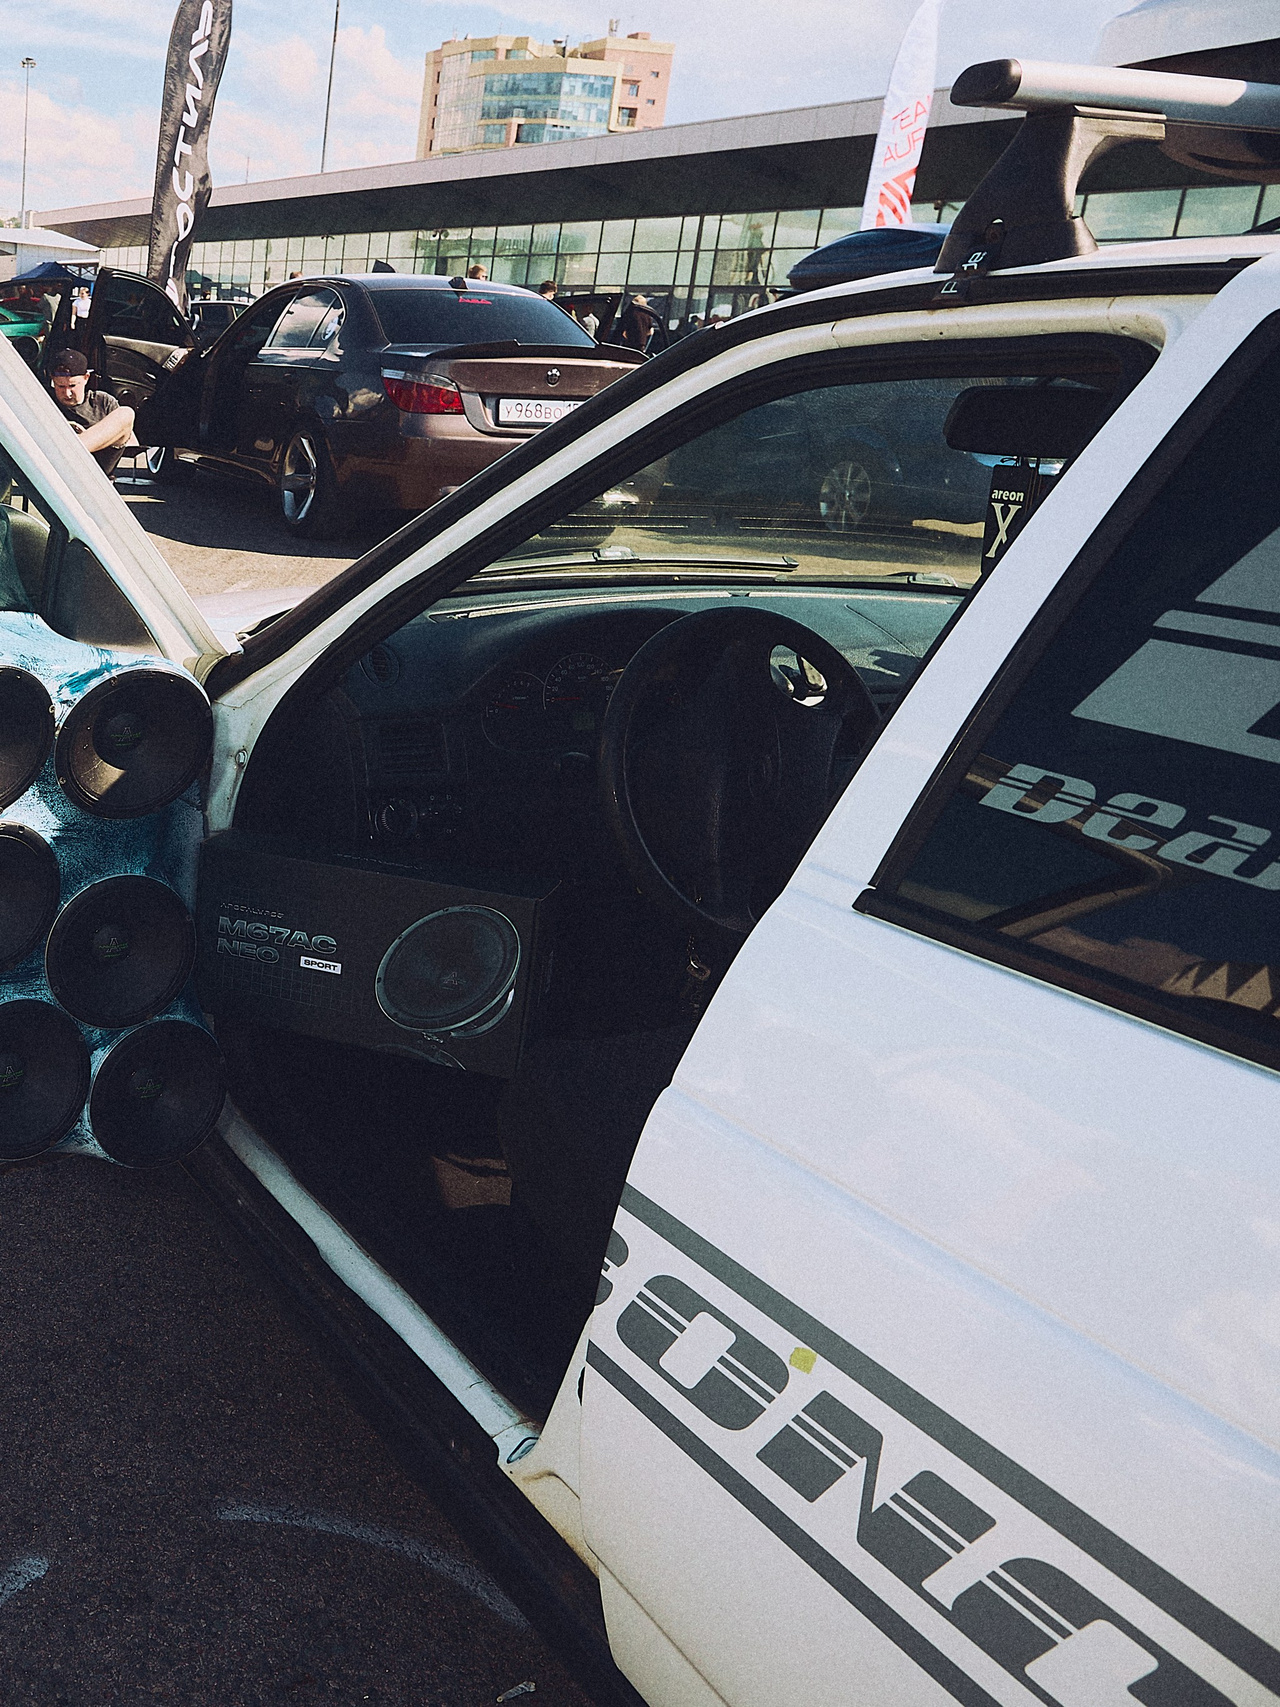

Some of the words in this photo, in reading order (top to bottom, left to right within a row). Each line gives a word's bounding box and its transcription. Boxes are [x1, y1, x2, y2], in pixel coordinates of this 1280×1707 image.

[991, 489, 1024, 502] areon
[984, 502, 1022, 558] X
[218, 916, 337, 954] M67AC
[217, 938, 280, 964] NEO
[303, 959, 338, 972] SPORT
